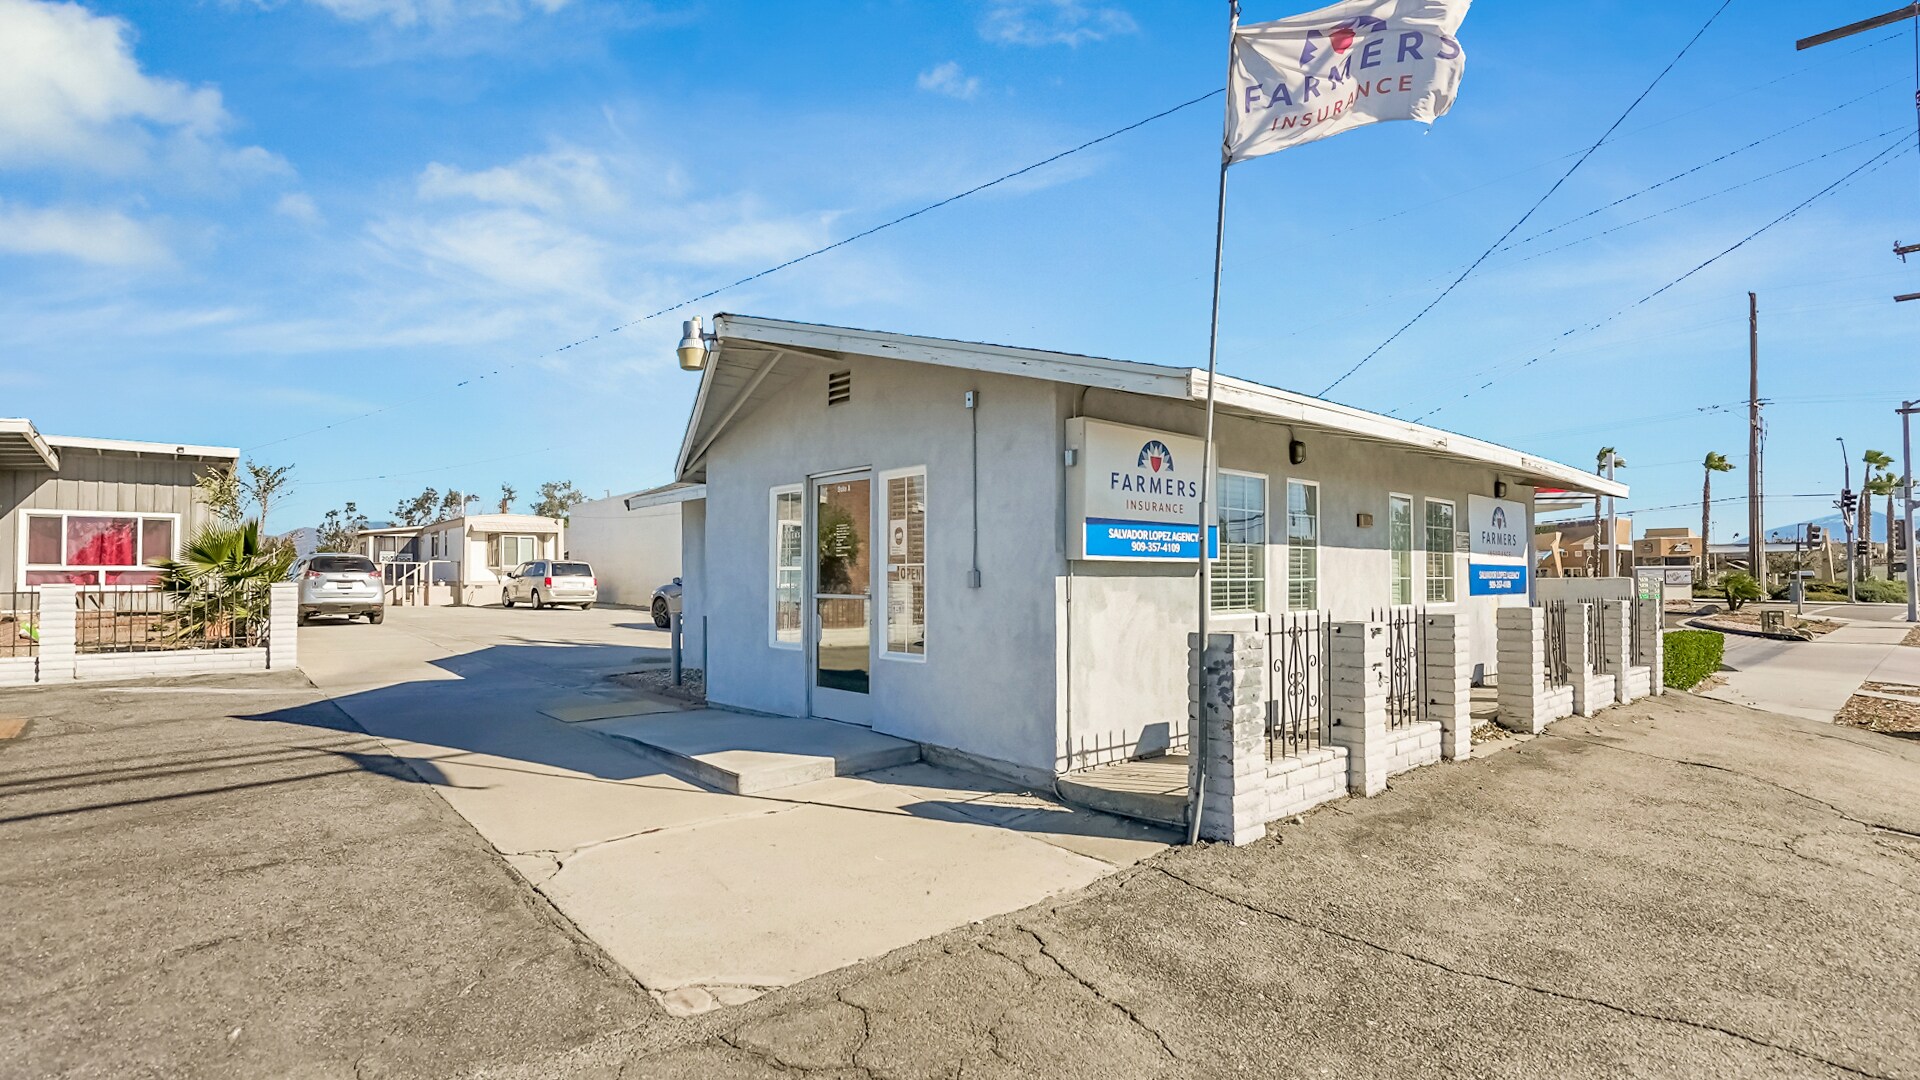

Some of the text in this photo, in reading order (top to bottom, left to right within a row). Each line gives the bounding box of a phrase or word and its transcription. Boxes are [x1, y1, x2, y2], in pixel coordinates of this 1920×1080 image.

[1245, 31, 1460, 113] FARMERS
[1272, 75, 1414, 131] INSURANCE
[1111, 472, 1197, 498] FARMERS
[1126, 499, 1184, 514] INSURANCE
[1108, 528, 1200, 543] SALVADOR LOPEZ AGENCY
[1481, 531, 1517, 546] FARMERS
[1131, 541, 1181, 553] 909-357-4109
[900, 568, 921, 581] OPEN
